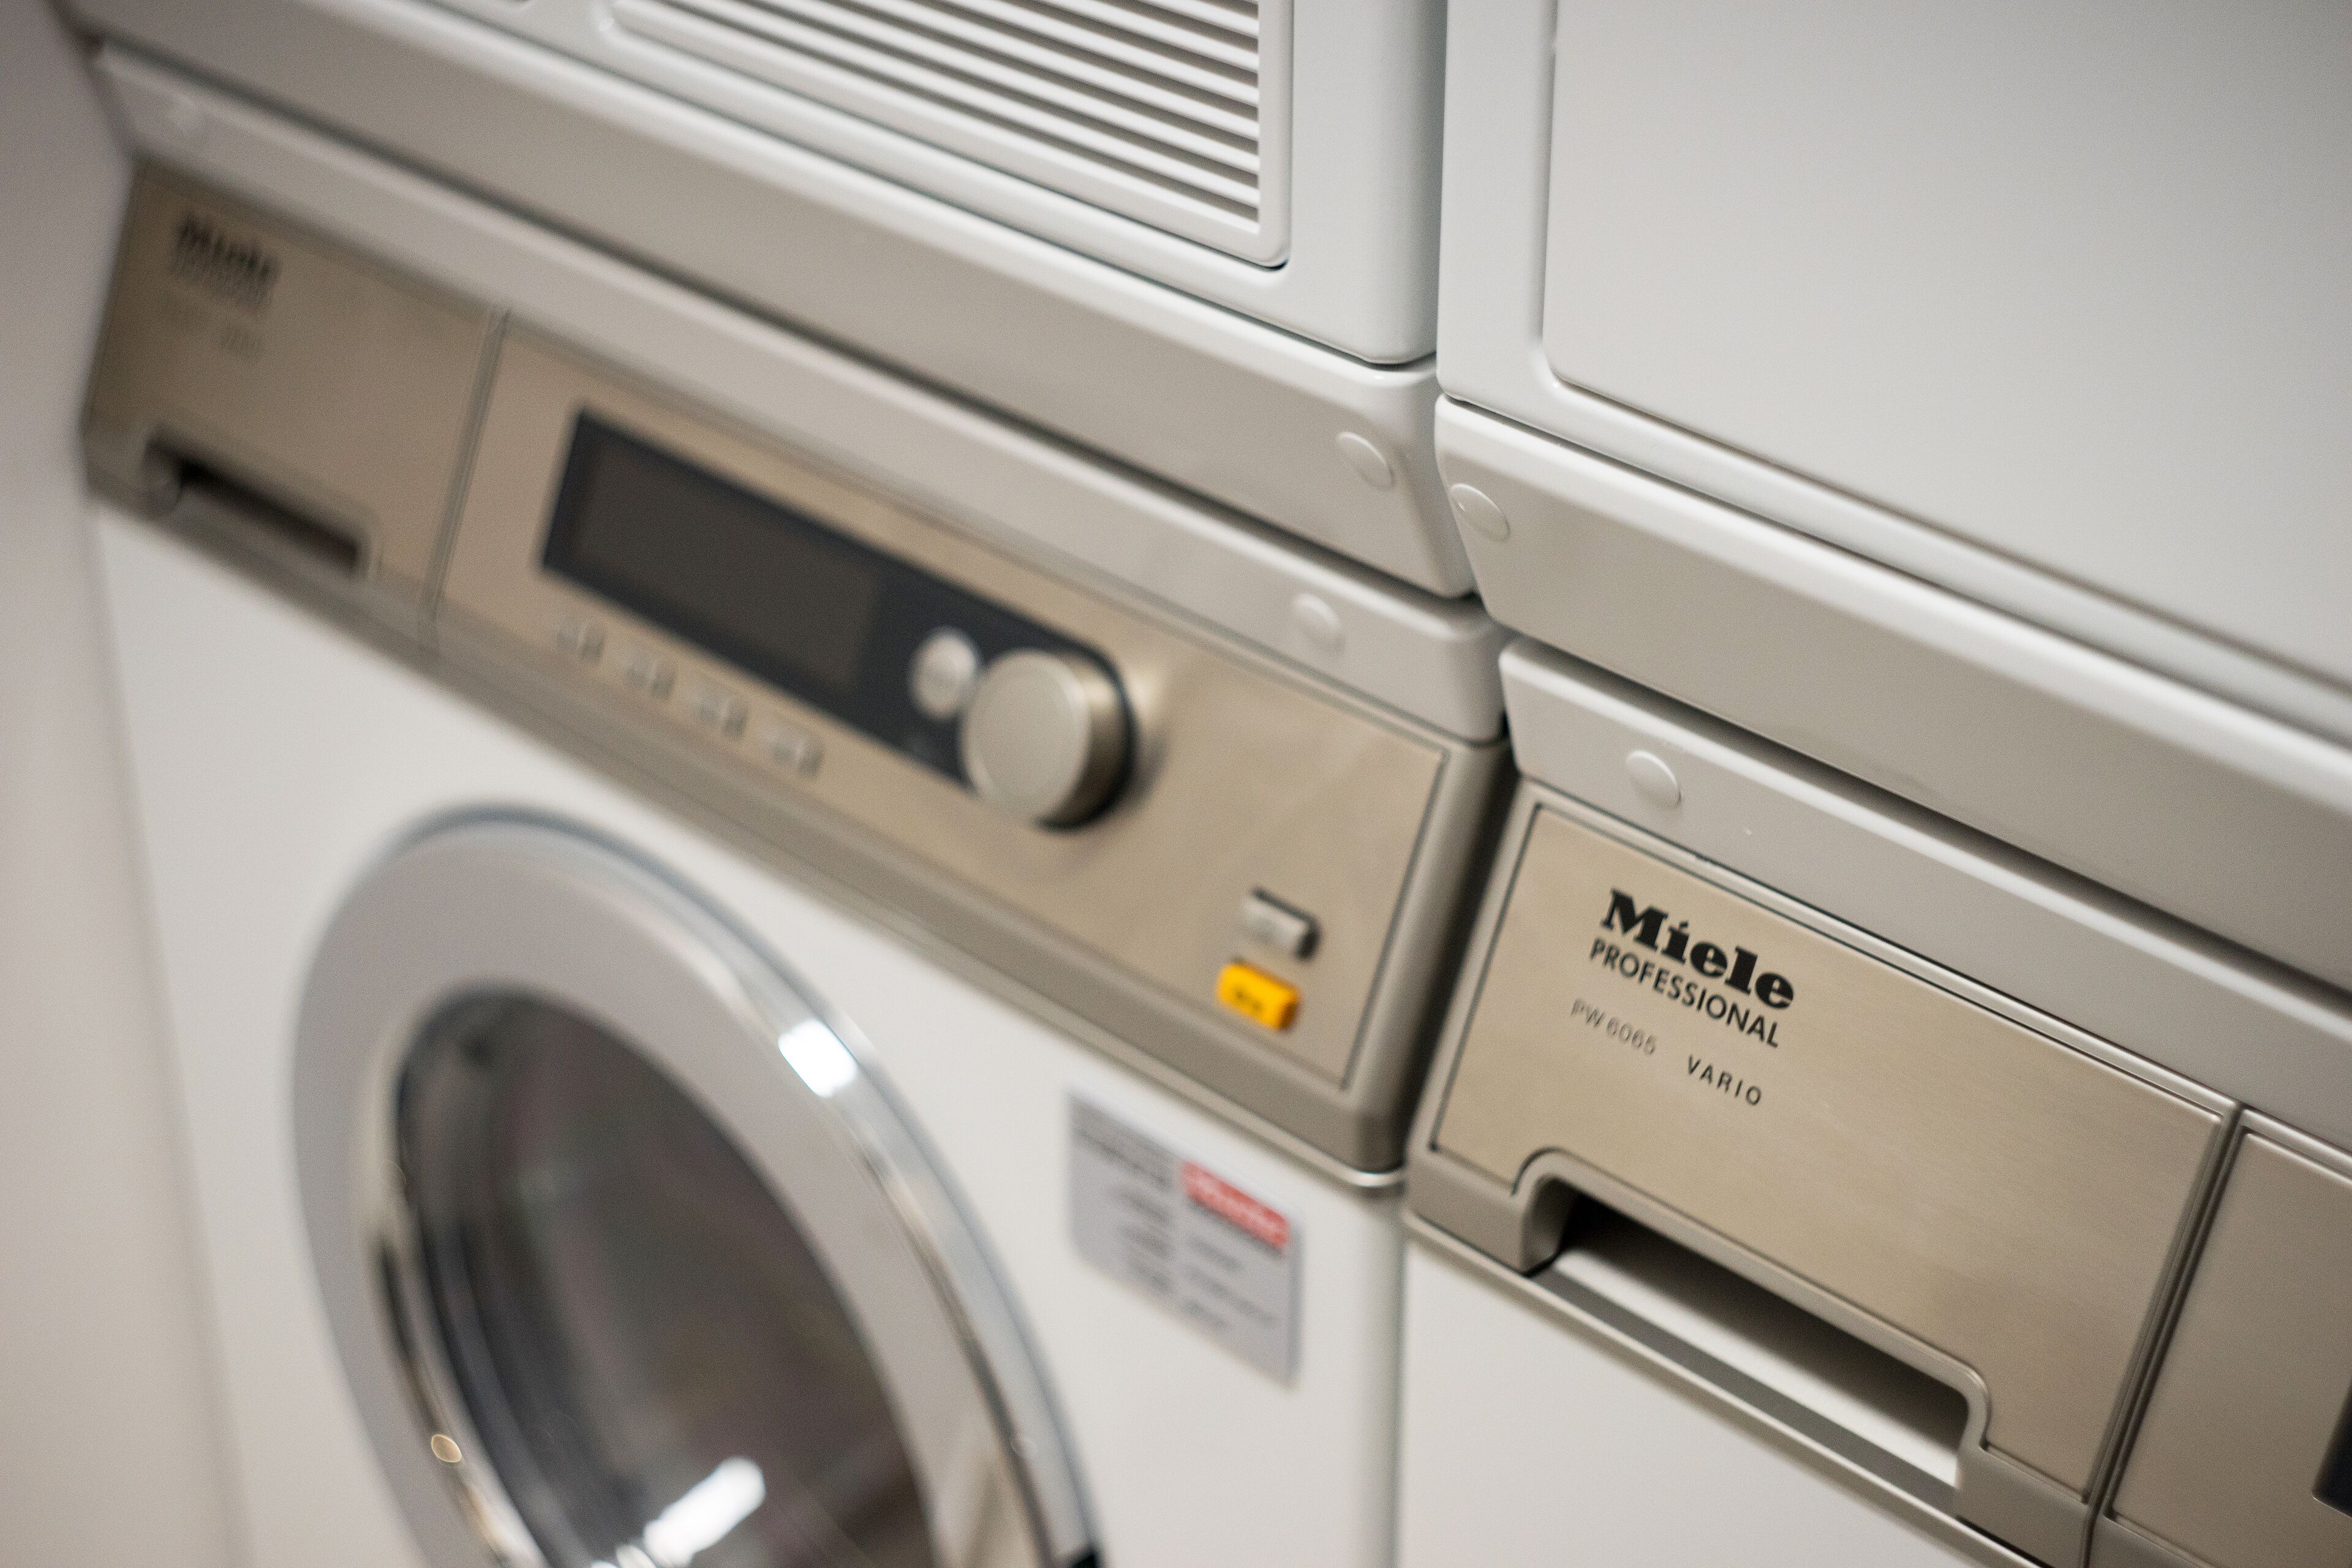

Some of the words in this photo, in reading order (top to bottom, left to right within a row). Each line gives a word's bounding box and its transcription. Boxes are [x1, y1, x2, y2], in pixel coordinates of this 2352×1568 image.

[1589, 938, 1778, 1048] PROFESSIONAL
[1600, 888, 1795, 1010] Miele
[1687, 1055, 1762, 1106] VARIO
